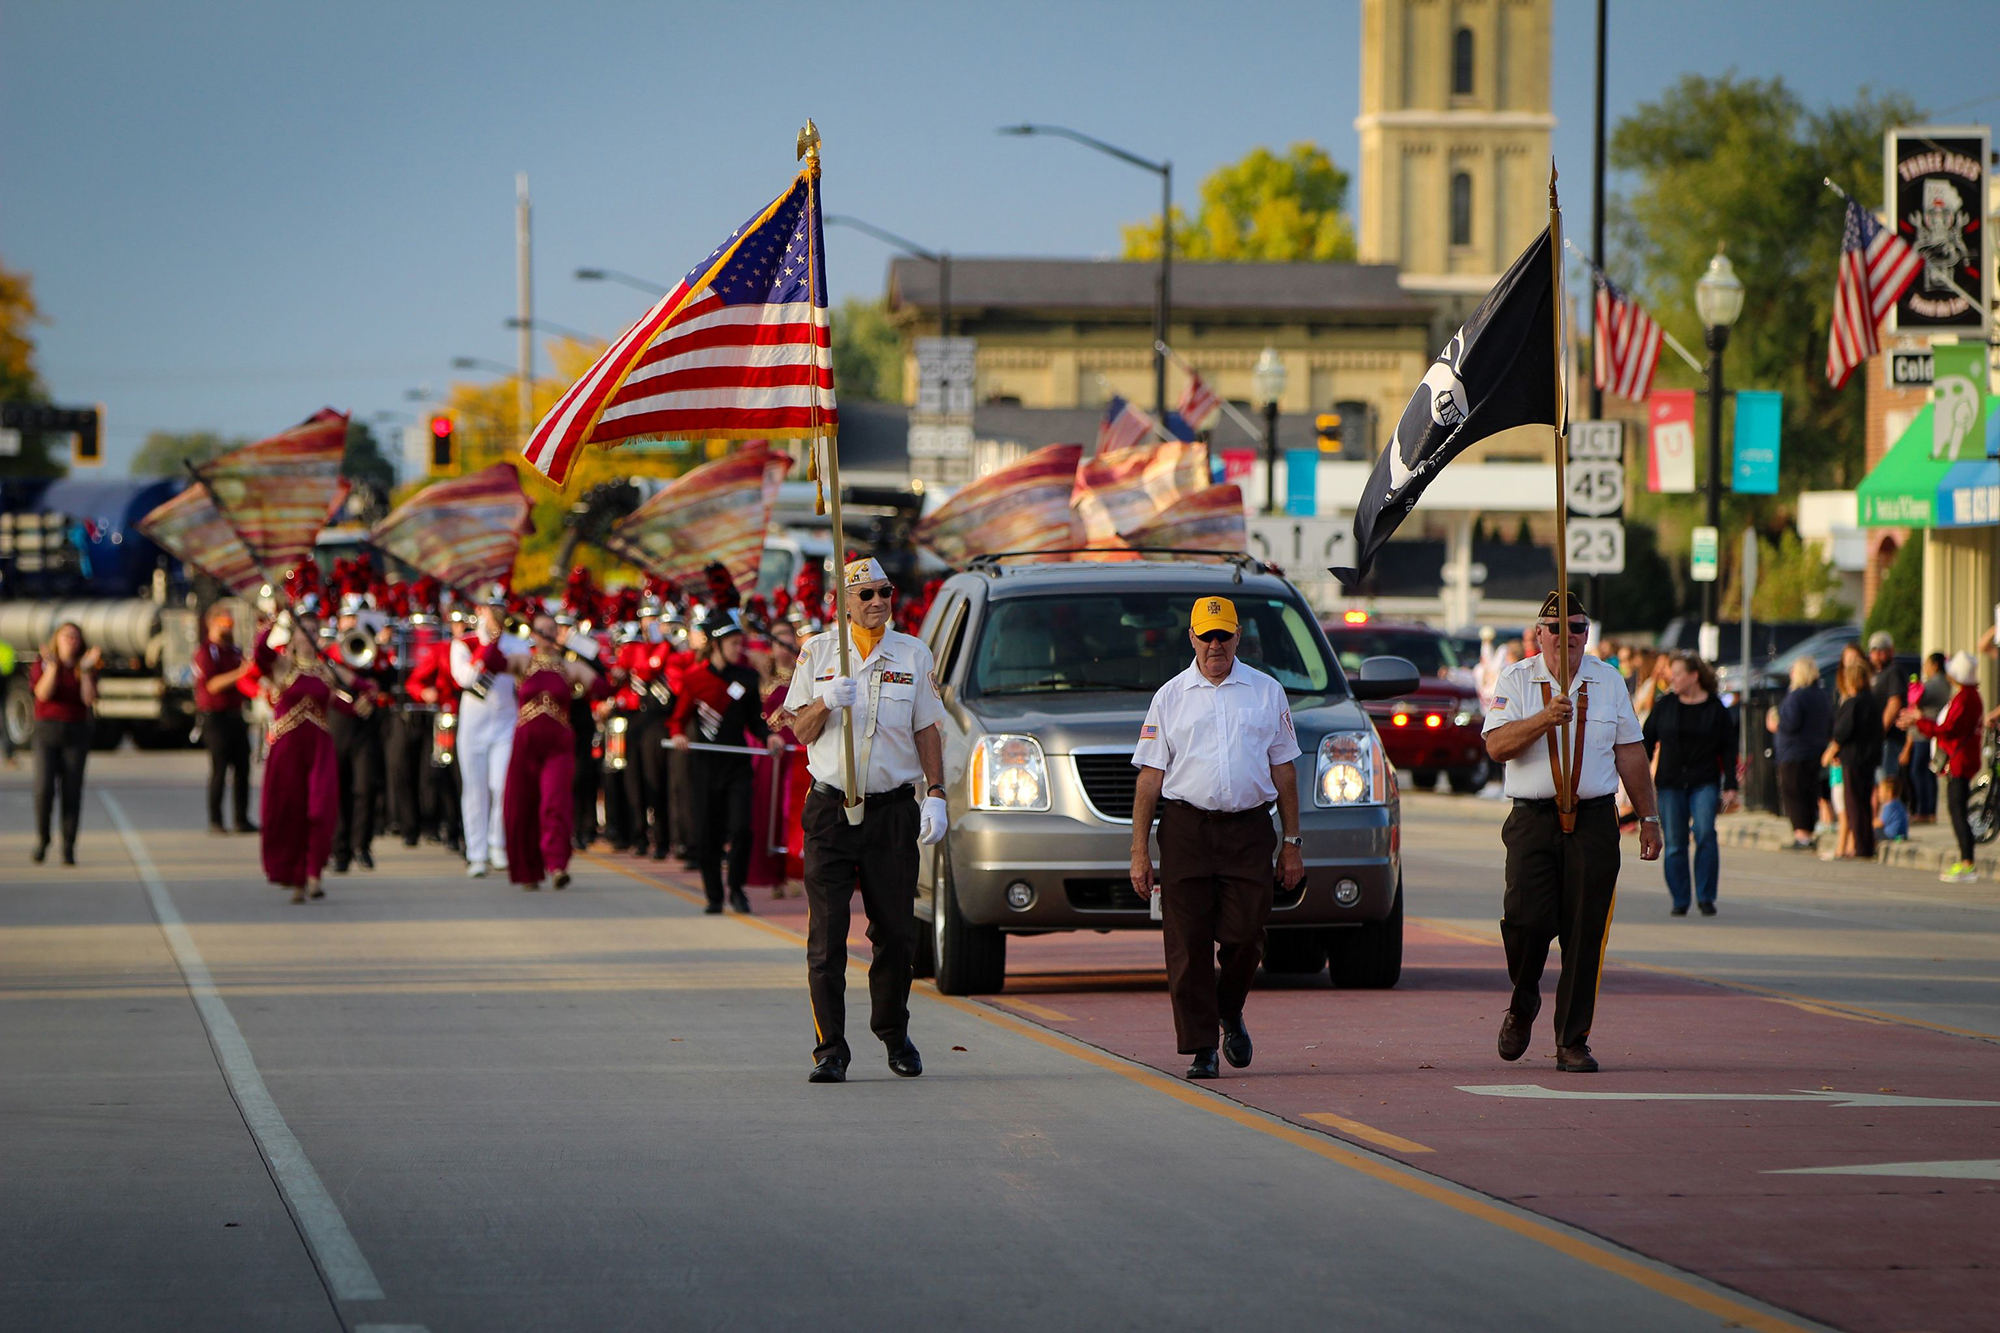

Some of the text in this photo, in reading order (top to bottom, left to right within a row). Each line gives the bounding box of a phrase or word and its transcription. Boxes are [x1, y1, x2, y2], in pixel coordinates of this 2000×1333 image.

[1898, 152, 1943, 182] THREE
[1894, 356, 1935, 382] Cold
[1575, 429, 1616, 450] JCT
[1574, 471, 1617, 503] 45
[1572, 529, 1616, 562] 23
